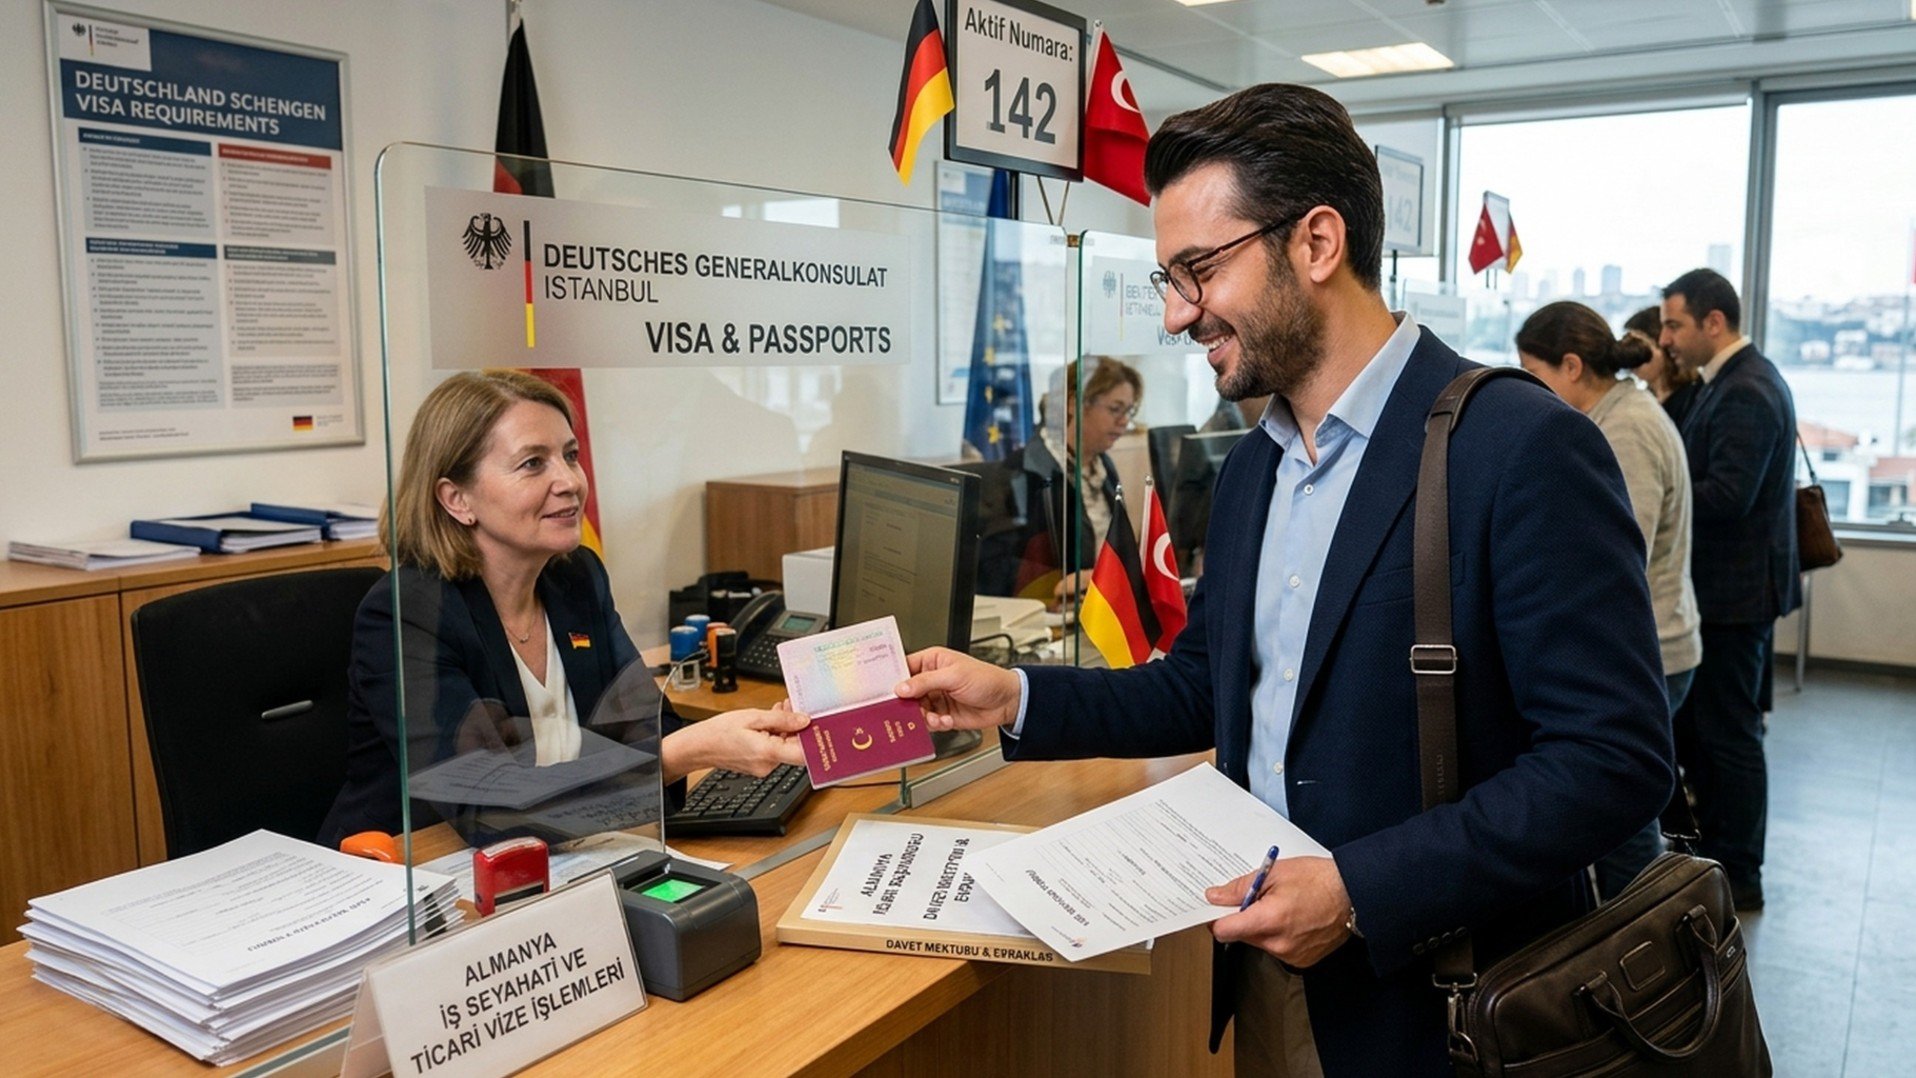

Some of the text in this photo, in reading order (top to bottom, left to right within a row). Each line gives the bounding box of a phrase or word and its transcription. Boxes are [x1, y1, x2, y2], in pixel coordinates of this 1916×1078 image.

[965, 7, 1073, 62] Aktif Numara:
[75, 70, 326, 121] DEUTSCHLAND SCHENGEN
[75, 93, 280, 135] VISA REQUIREMENTS
[985, 68, 1056, 145] 142
[544, 243, 888, 288] DEUTSCHES GENERALKONSULAT
[545, 275, 659, 303] ISTANBUL
[645, 321, 891, 354] VISA & PASSPORTS
[465, 932, 557, 987] ALMANYA
[886, 939, 922, 951] DAVET
[924, 942, 979, 956] MEKTUBU
[982, 947, 991, 958] &
[440, 948, 587, 1030] İŞ SEYAHATİ VE
[410, 956, 625, 1074] TİCARİ VİZE İŞLEMLERİ
